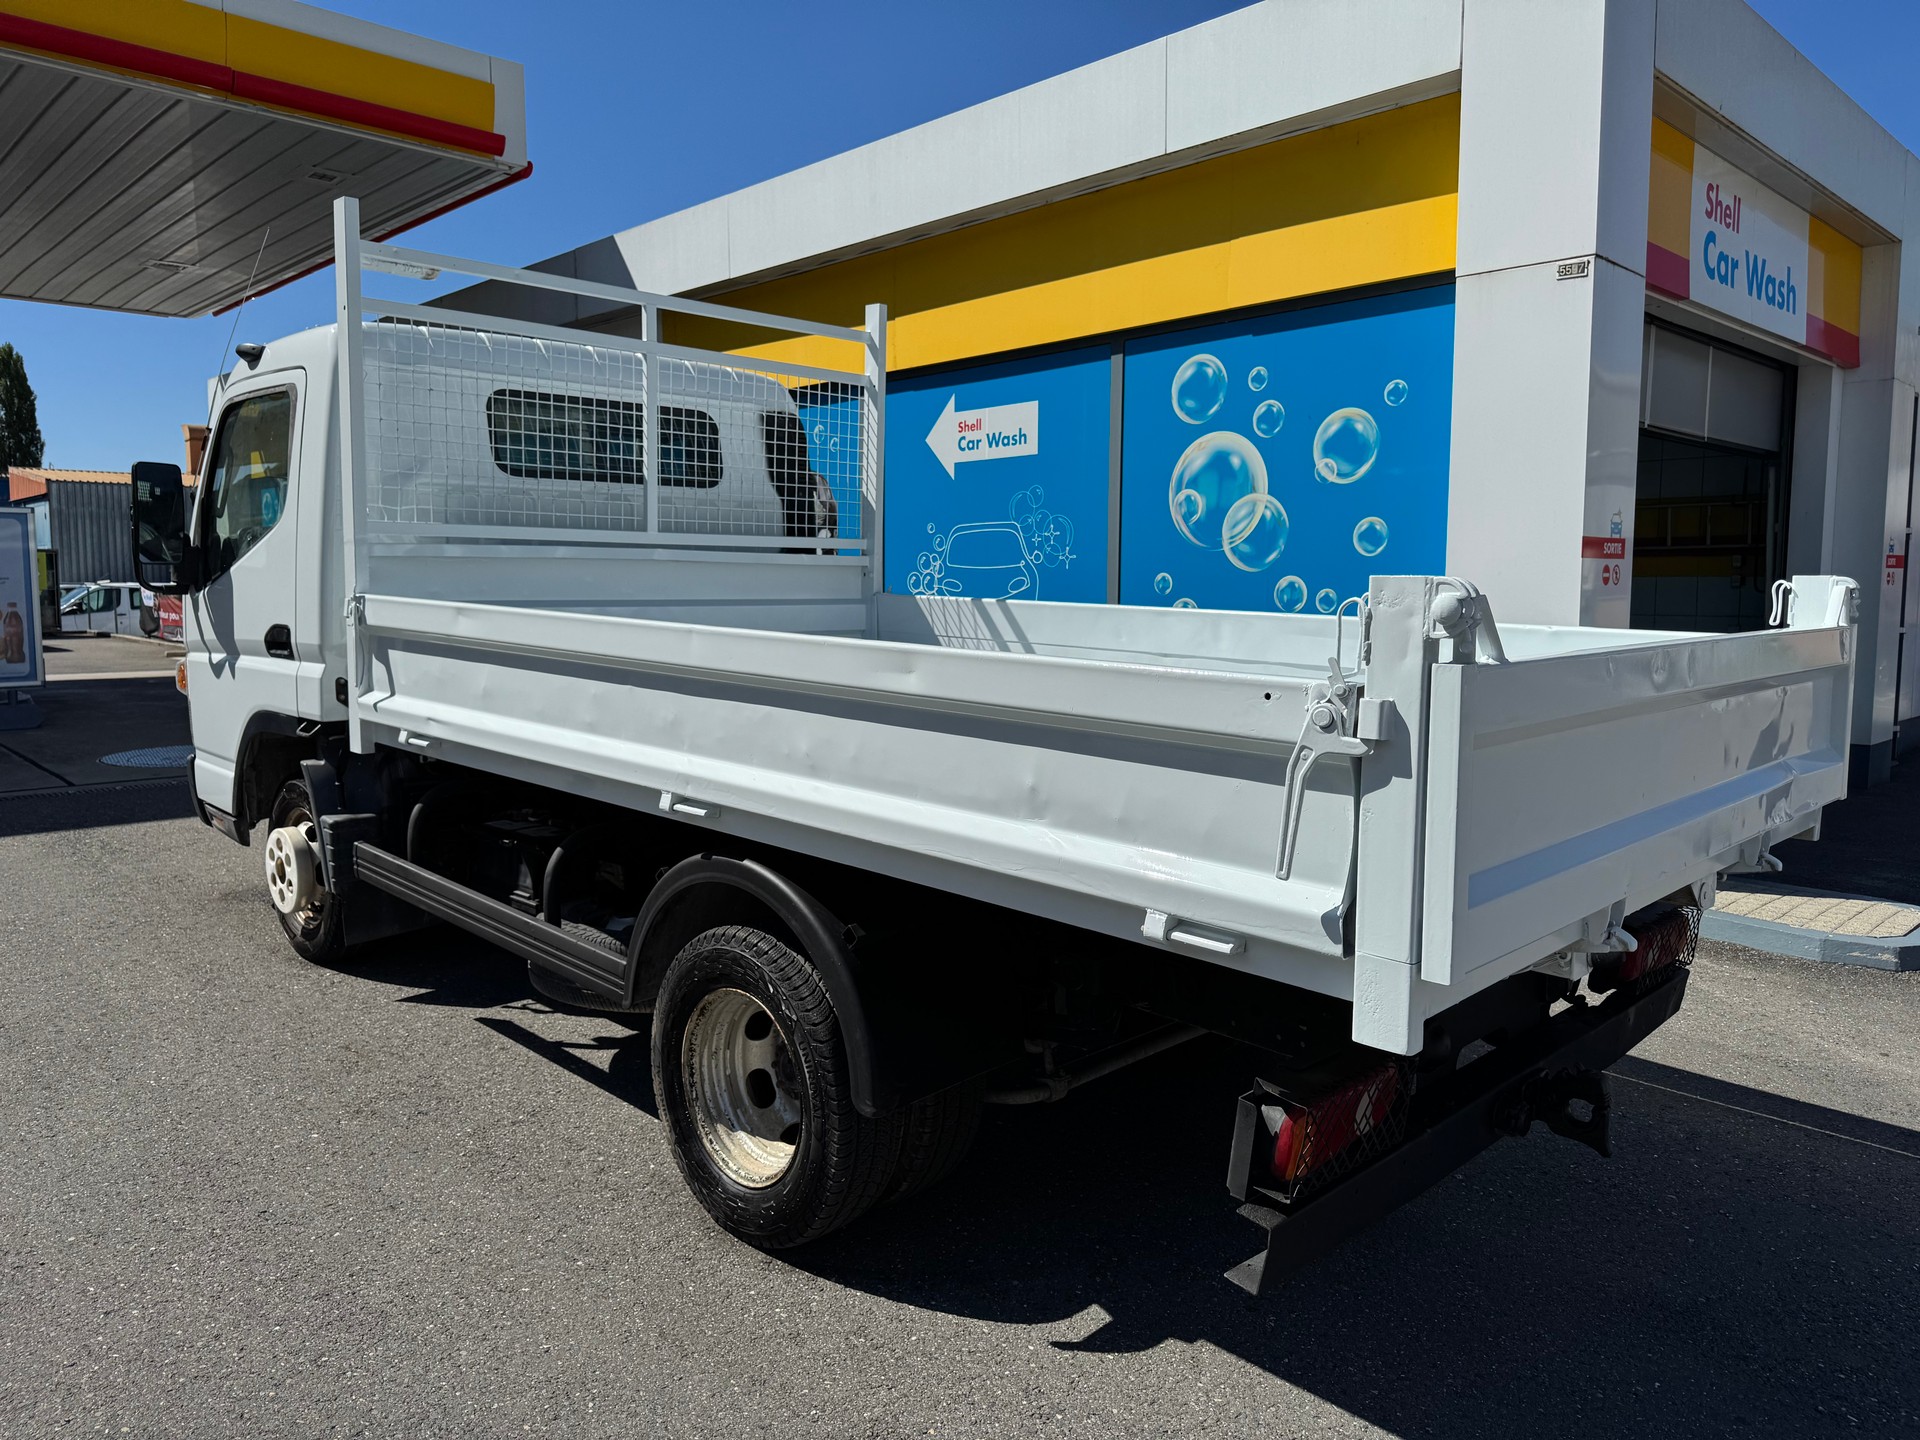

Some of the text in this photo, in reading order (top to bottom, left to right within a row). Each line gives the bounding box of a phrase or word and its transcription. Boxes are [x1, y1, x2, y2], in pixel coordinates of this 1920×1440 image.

[1705, 183, 1741, 234] Shell
[1703, 230, 1796, 315] Car Wash
[958, 418, 982, 433] Shell
[958, 427, 1027, 451] Car Wash
[1603, 542, 1622, 554] SORTIE
[799, 1041, 821, 1120] UNIROYAL
